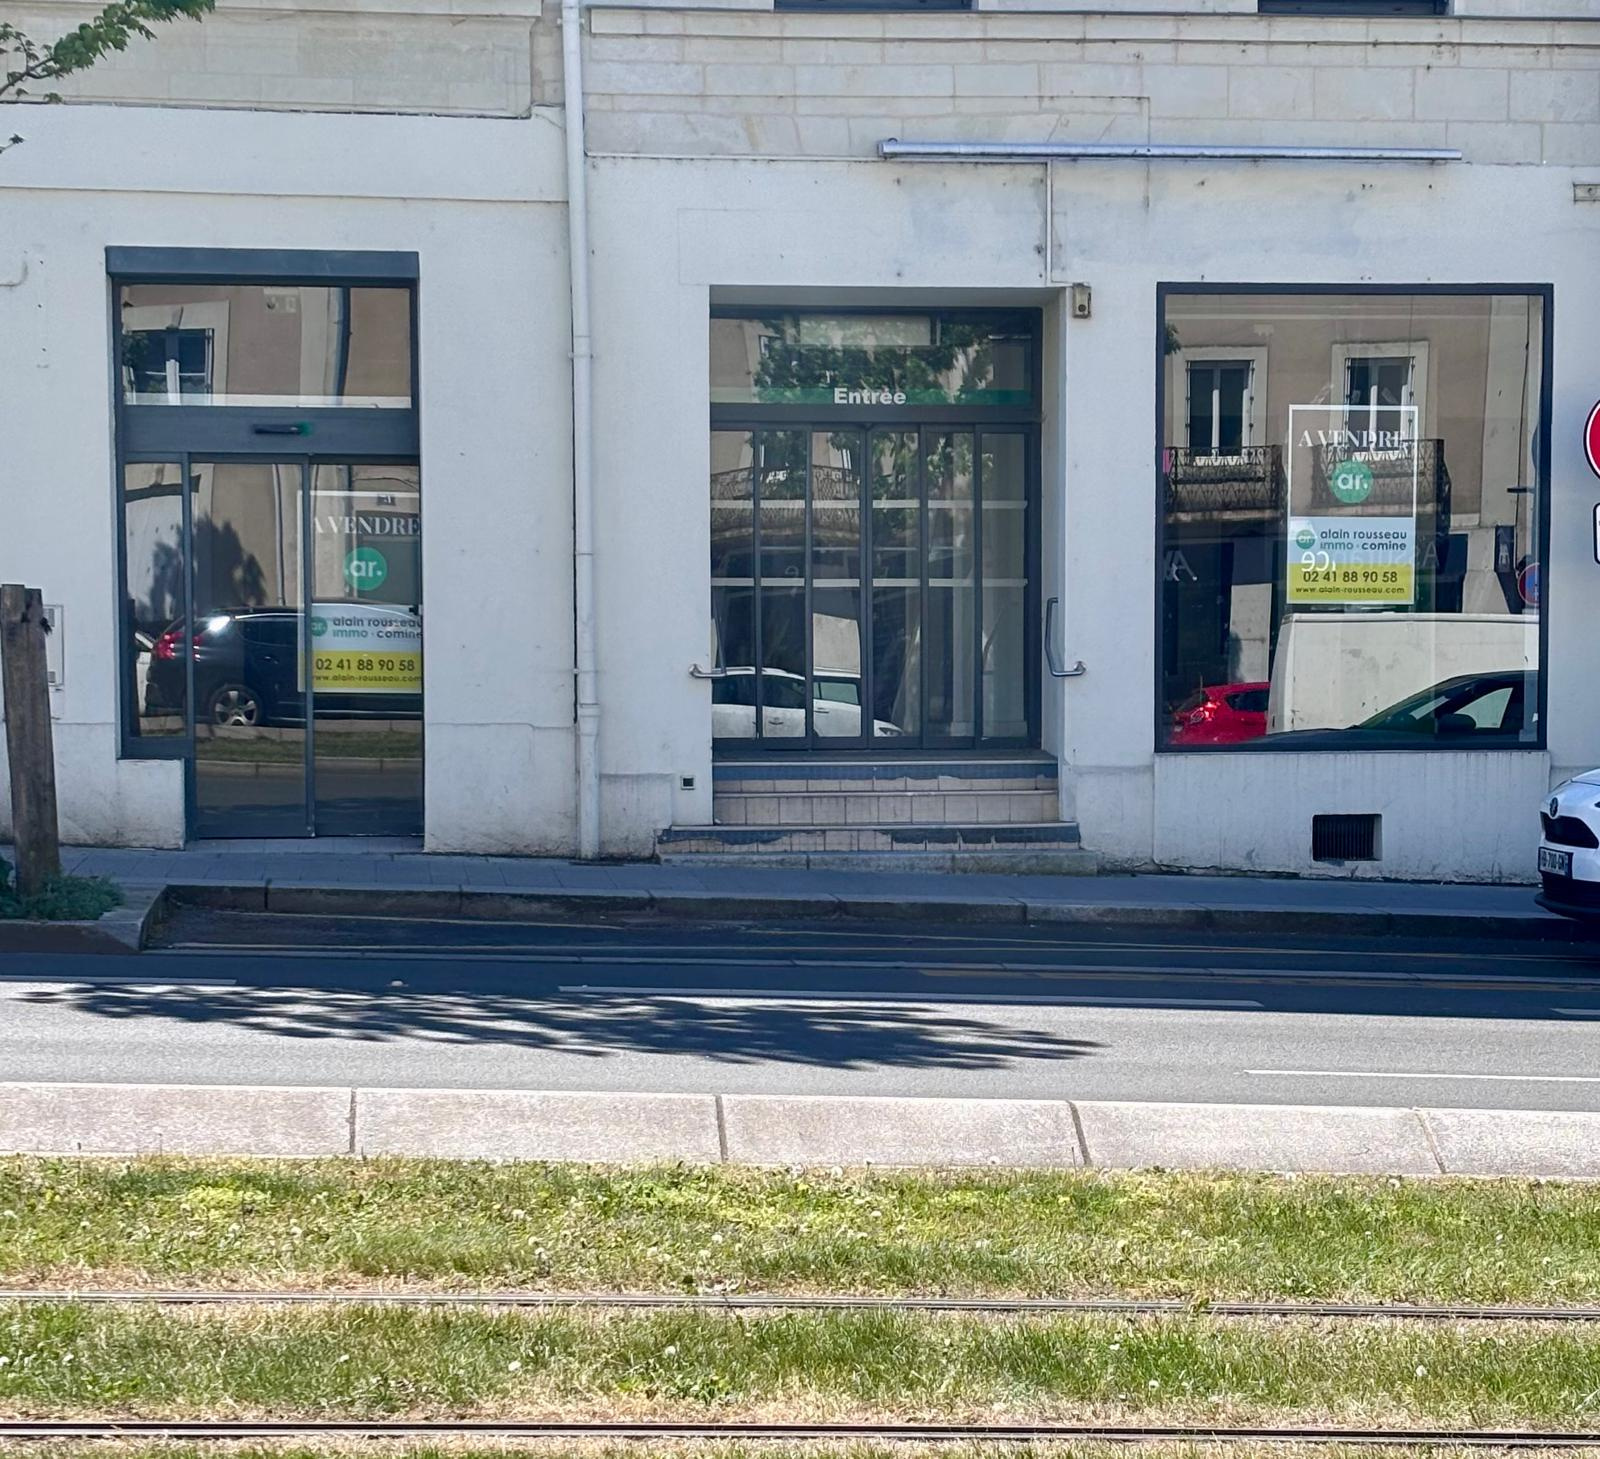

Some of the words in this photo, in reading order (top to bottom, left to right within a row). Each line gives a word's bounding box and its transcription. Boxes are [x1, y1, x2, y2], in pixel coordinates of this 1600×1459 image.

[1298, 430, 1314, 447] A
[1318, 430, 1406, 448] VENDRE
[327, 515, 421, 535] VENDRE
[1320, 528, 1350, 540] alain
[1353, 529, 1407, 540] rousseau
[1320, 540, 1354, 551] immo
[1361, 540, 1407, 551] comine
[1303, 571, 1319, 582] 02
[1323, 571, 1337, 582] 41
[1342, 571, 1358, 583] 88
[1362, 571, 1378, 583] 90
[1382, 571, 1398, 583] 58
[1295, 586, 1405, 594] www.alain-rousseau.com
[332, 616, 364, 627] alain
[332, 628, 368, 638] immo
[315, 658, 332, 671] 02
[336, 658, 351, 671] 41
[357, 659, 374, 671] 88
[378, 659, 395, 672] 90
[399, 659, 415, 672] 58
